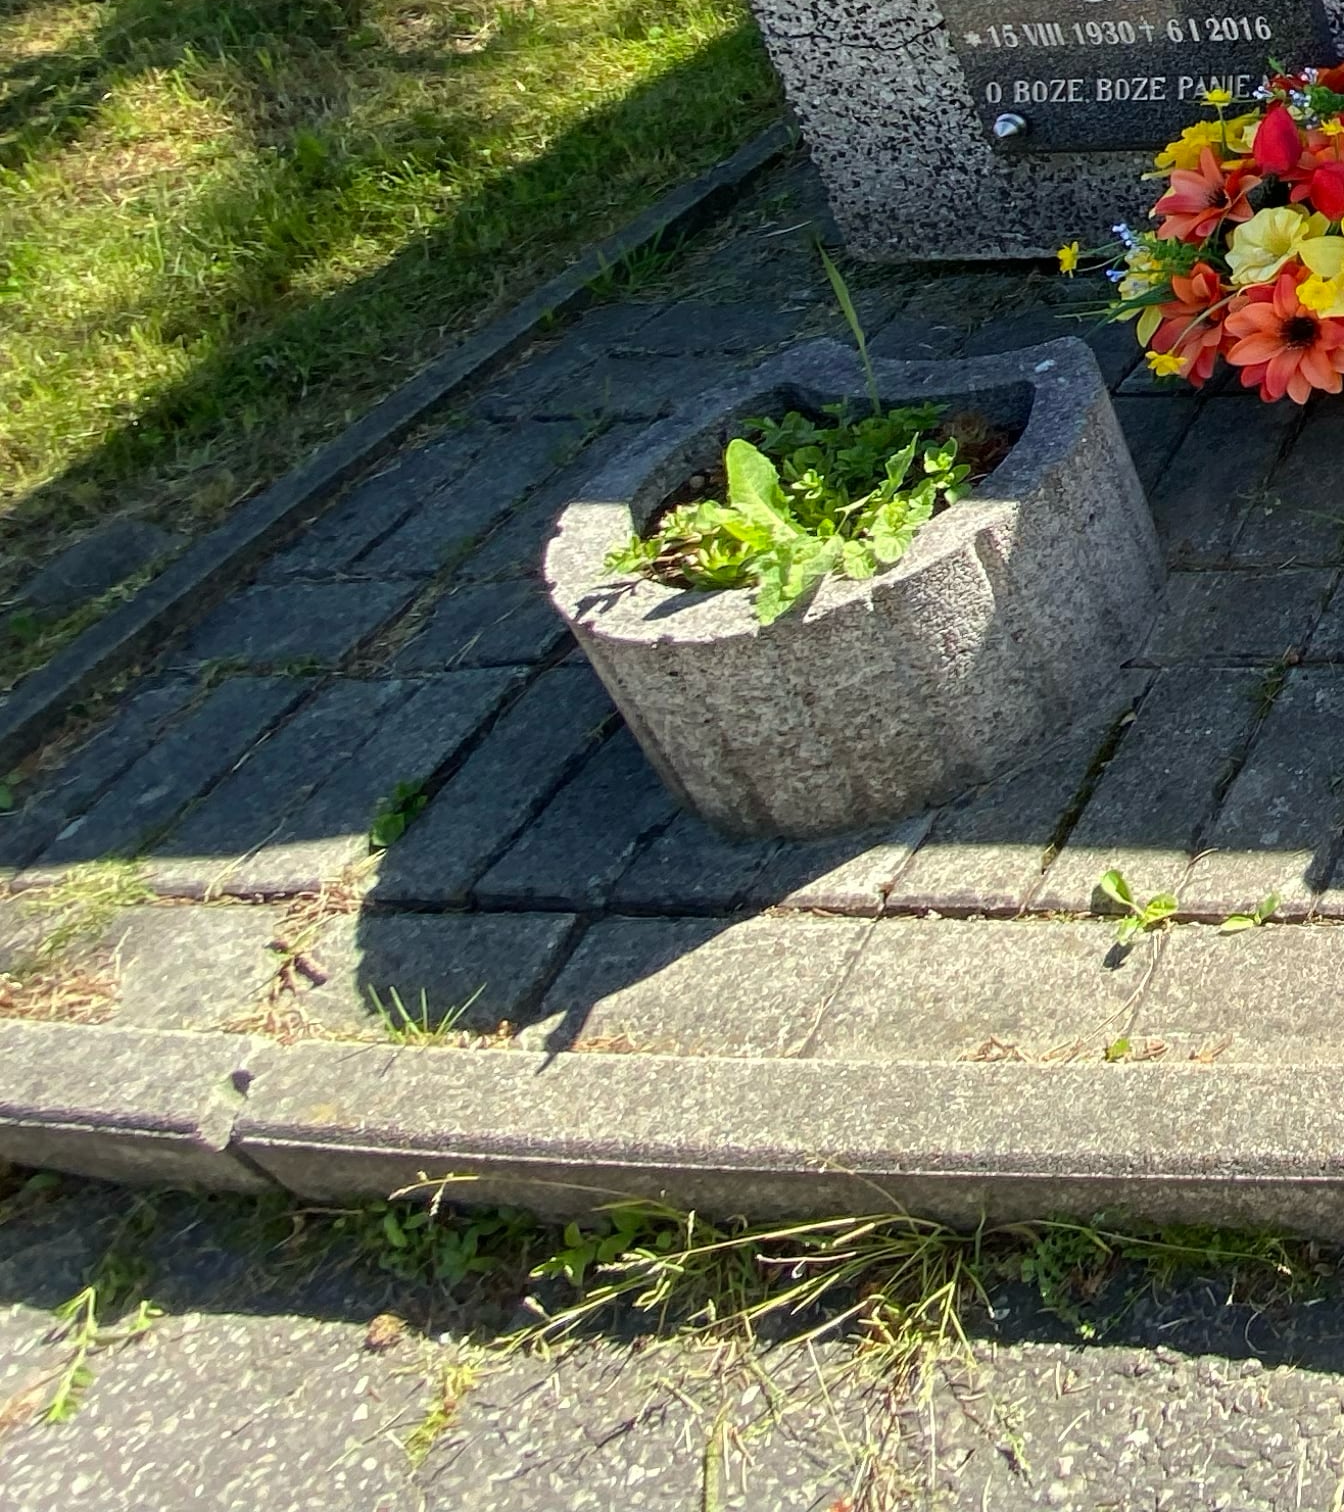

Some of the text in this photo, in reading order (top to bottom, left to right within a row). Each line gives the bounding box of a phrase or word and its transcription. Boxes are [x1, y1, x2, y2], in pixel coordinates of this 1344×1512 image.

[986, 24, 1019, 48] 15
[1022, 22, 1065, 47] VIII
[1072, 20, 1136, 45] 1930
[1166, 19, 1183, 42] 6
[1205, 16, 1272, 41] 2016
[985, 81, 1002, 104] O
